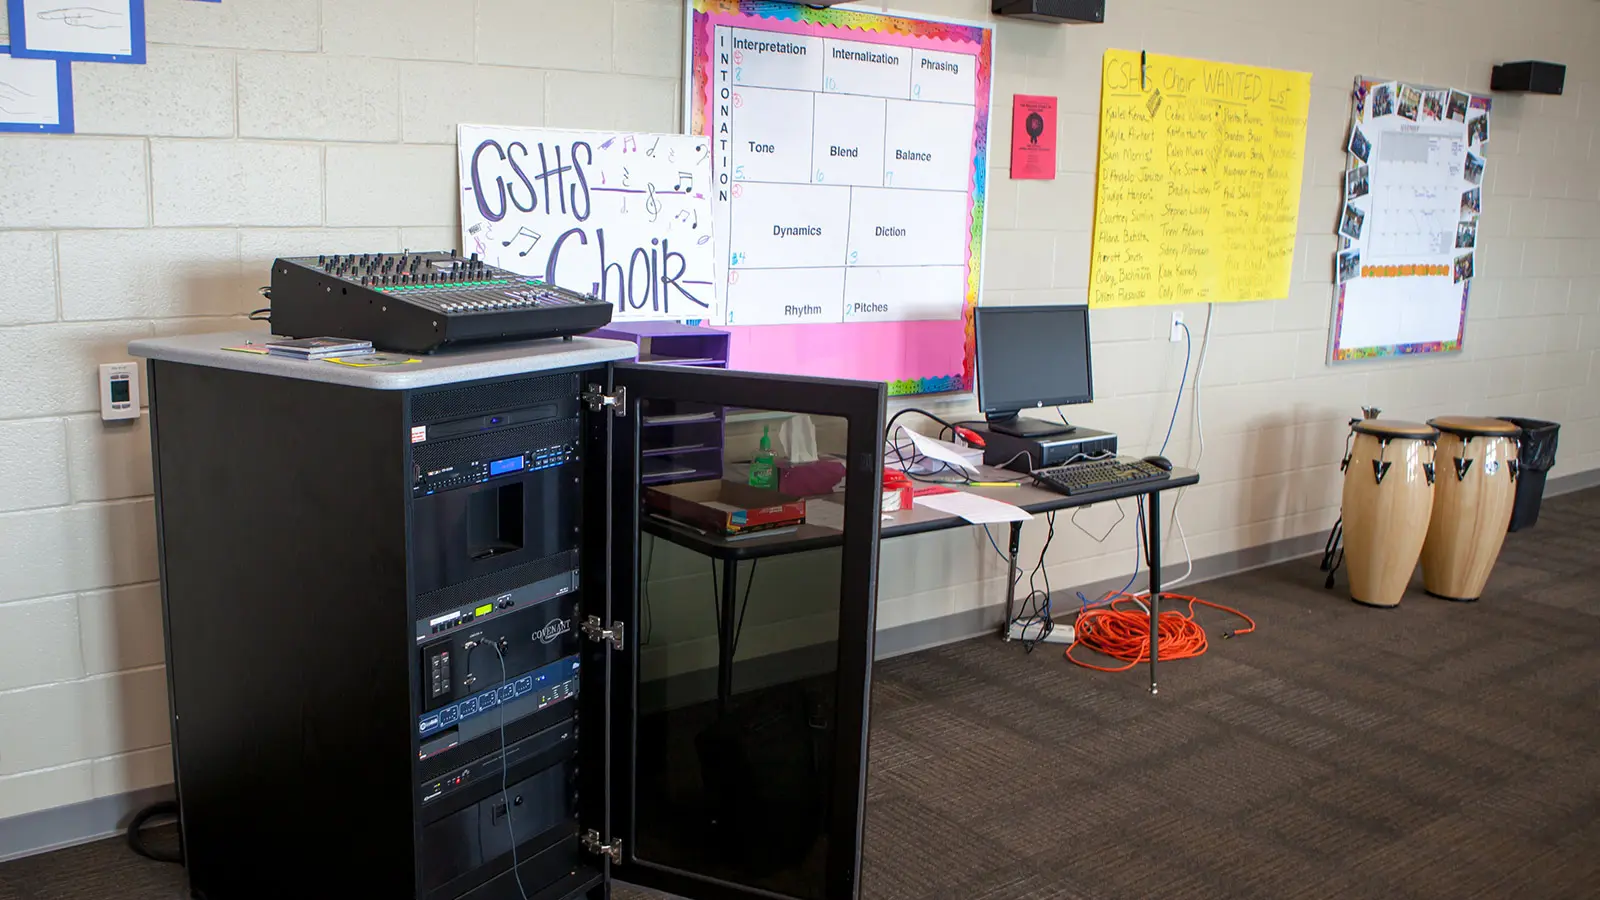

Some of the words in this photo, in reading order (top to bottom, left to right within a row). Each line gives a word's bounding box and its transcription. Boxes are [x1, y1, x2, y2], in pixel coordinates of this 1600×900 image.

[733, 36, 807, 56] Interpretation
[832, 48, 899, 66] Internalization
[920, 58, 959, 74] Phrasing
[1163, 67, 1196, 92] Choir
[1203, 65, 1263, 102] WANTED
[1269, 77, 1291, 104] List
[748, 141, 775, 154] Tone
[830, 146, 858, 158] Blend
[895, 150, 932, 162] Balance
[471, 139, 592, 222] CSHS
[773, 225, 822, 237] Dynamics
[875, 226, 906, 237] Diction
[784, 304, 822, 317] Rhythm
[853, 302, 888, 313] Pitches
[532, 619, 571, 641] COVENANT
